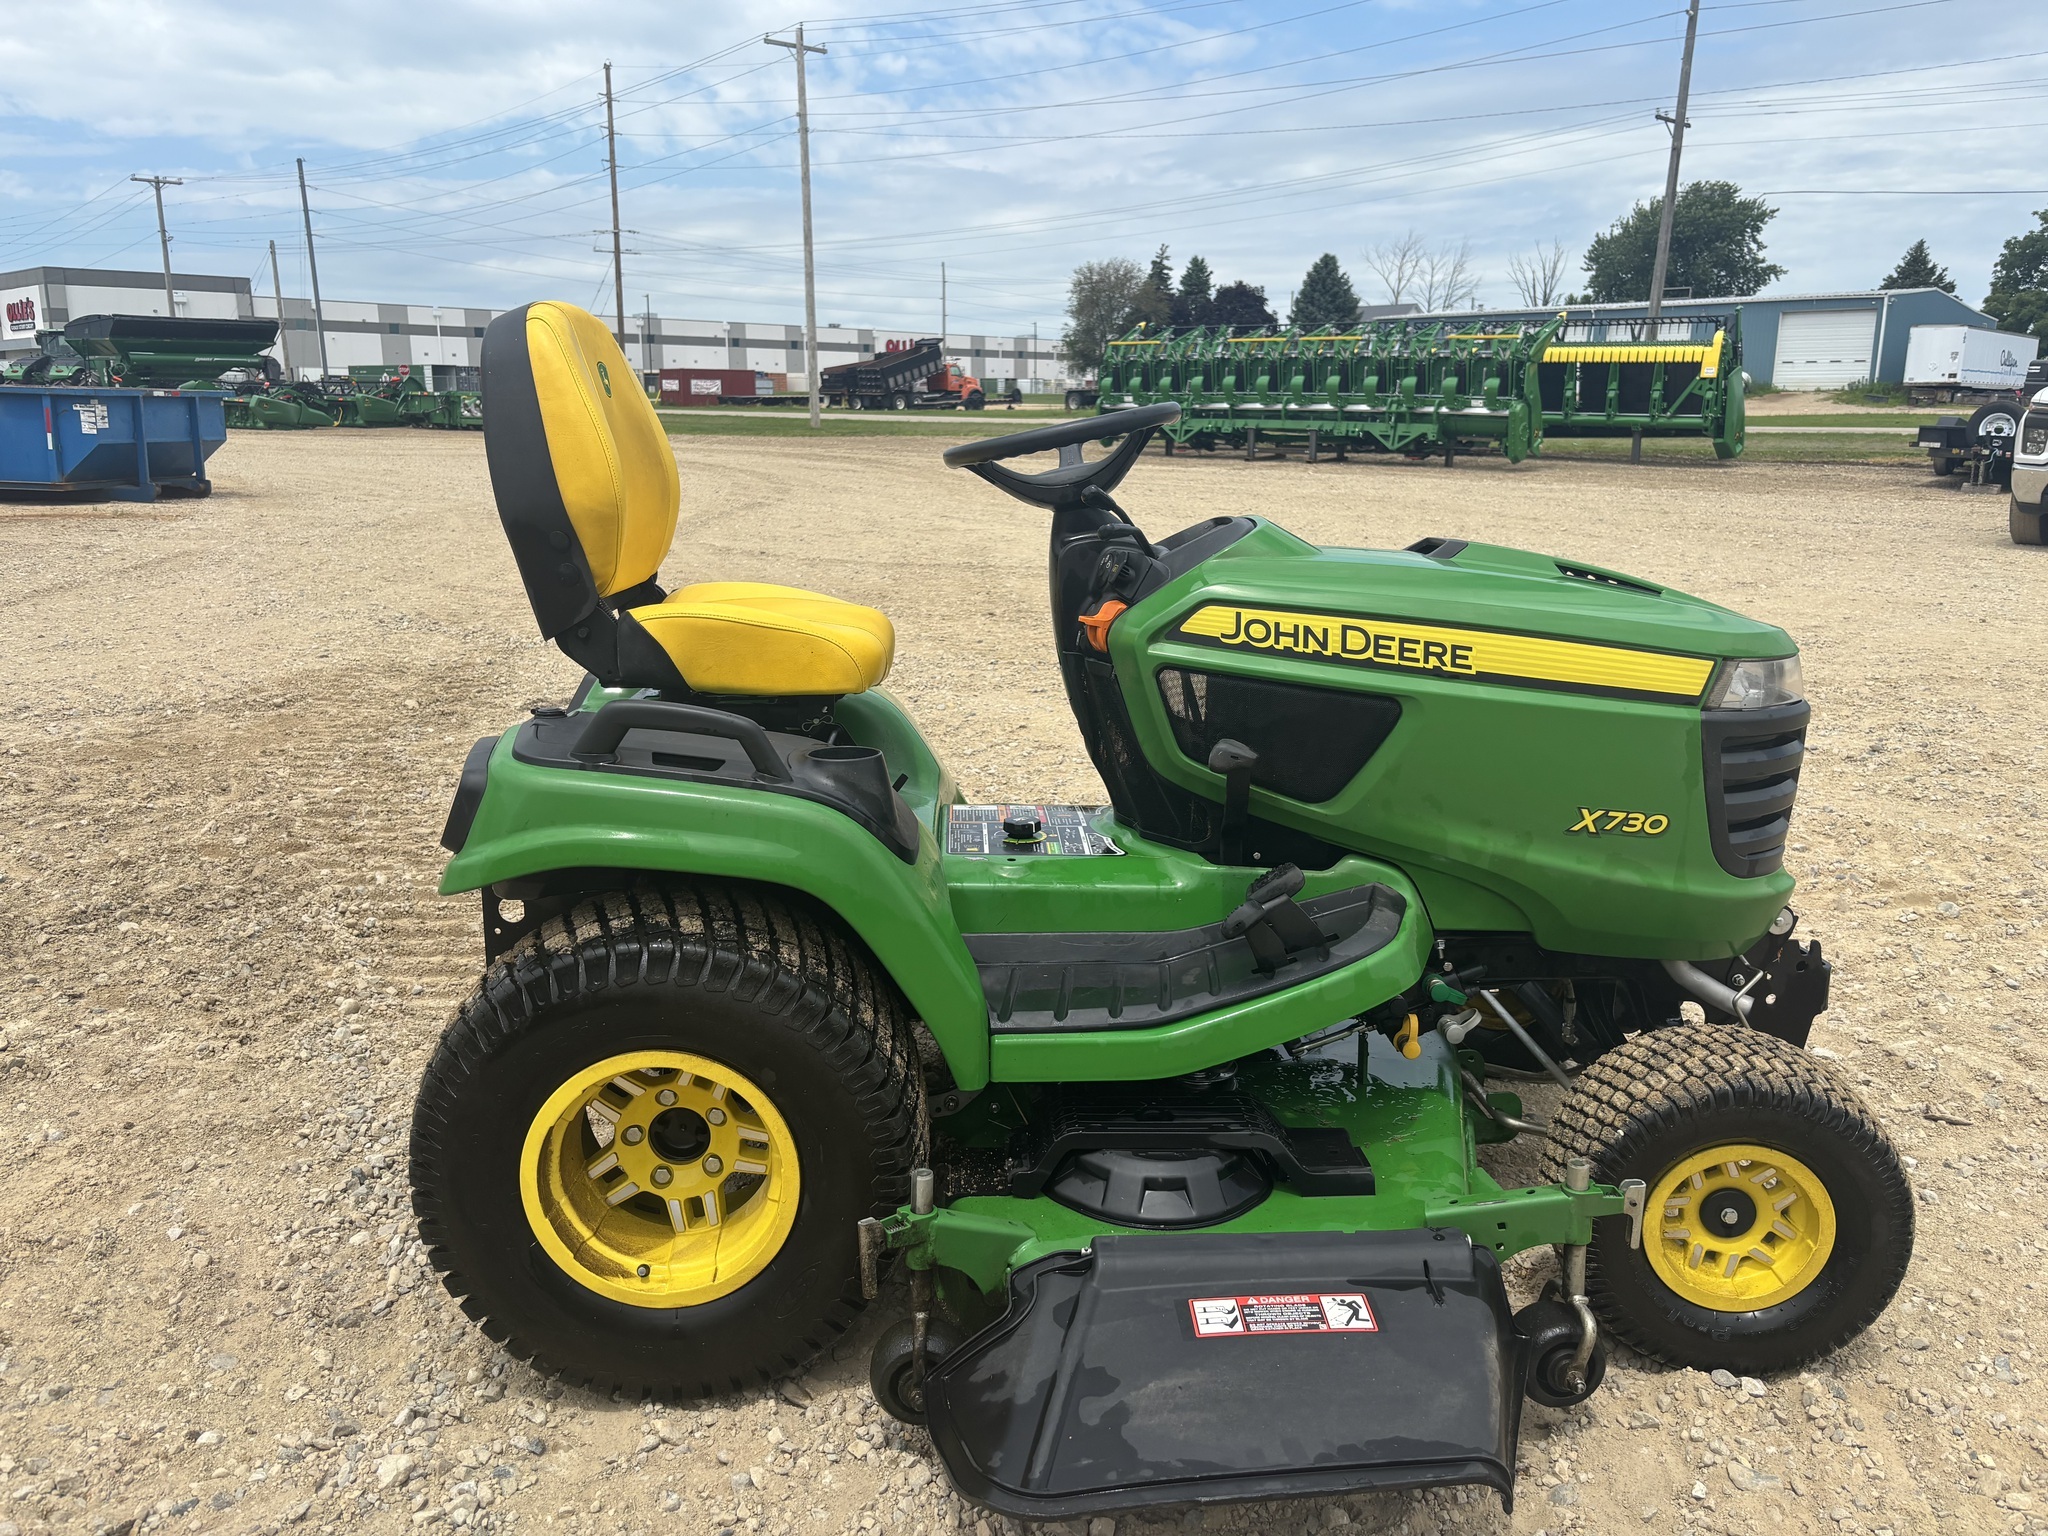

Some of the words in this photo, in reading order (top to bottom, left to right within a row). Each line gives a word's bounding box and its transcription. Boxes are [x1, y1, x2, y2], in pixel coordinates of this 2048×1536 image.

[1220, 611, 1333, 654] JOHN
[1340, 624, 1475, 672] DEERE
[1567, 807, 1669, 835] X730
